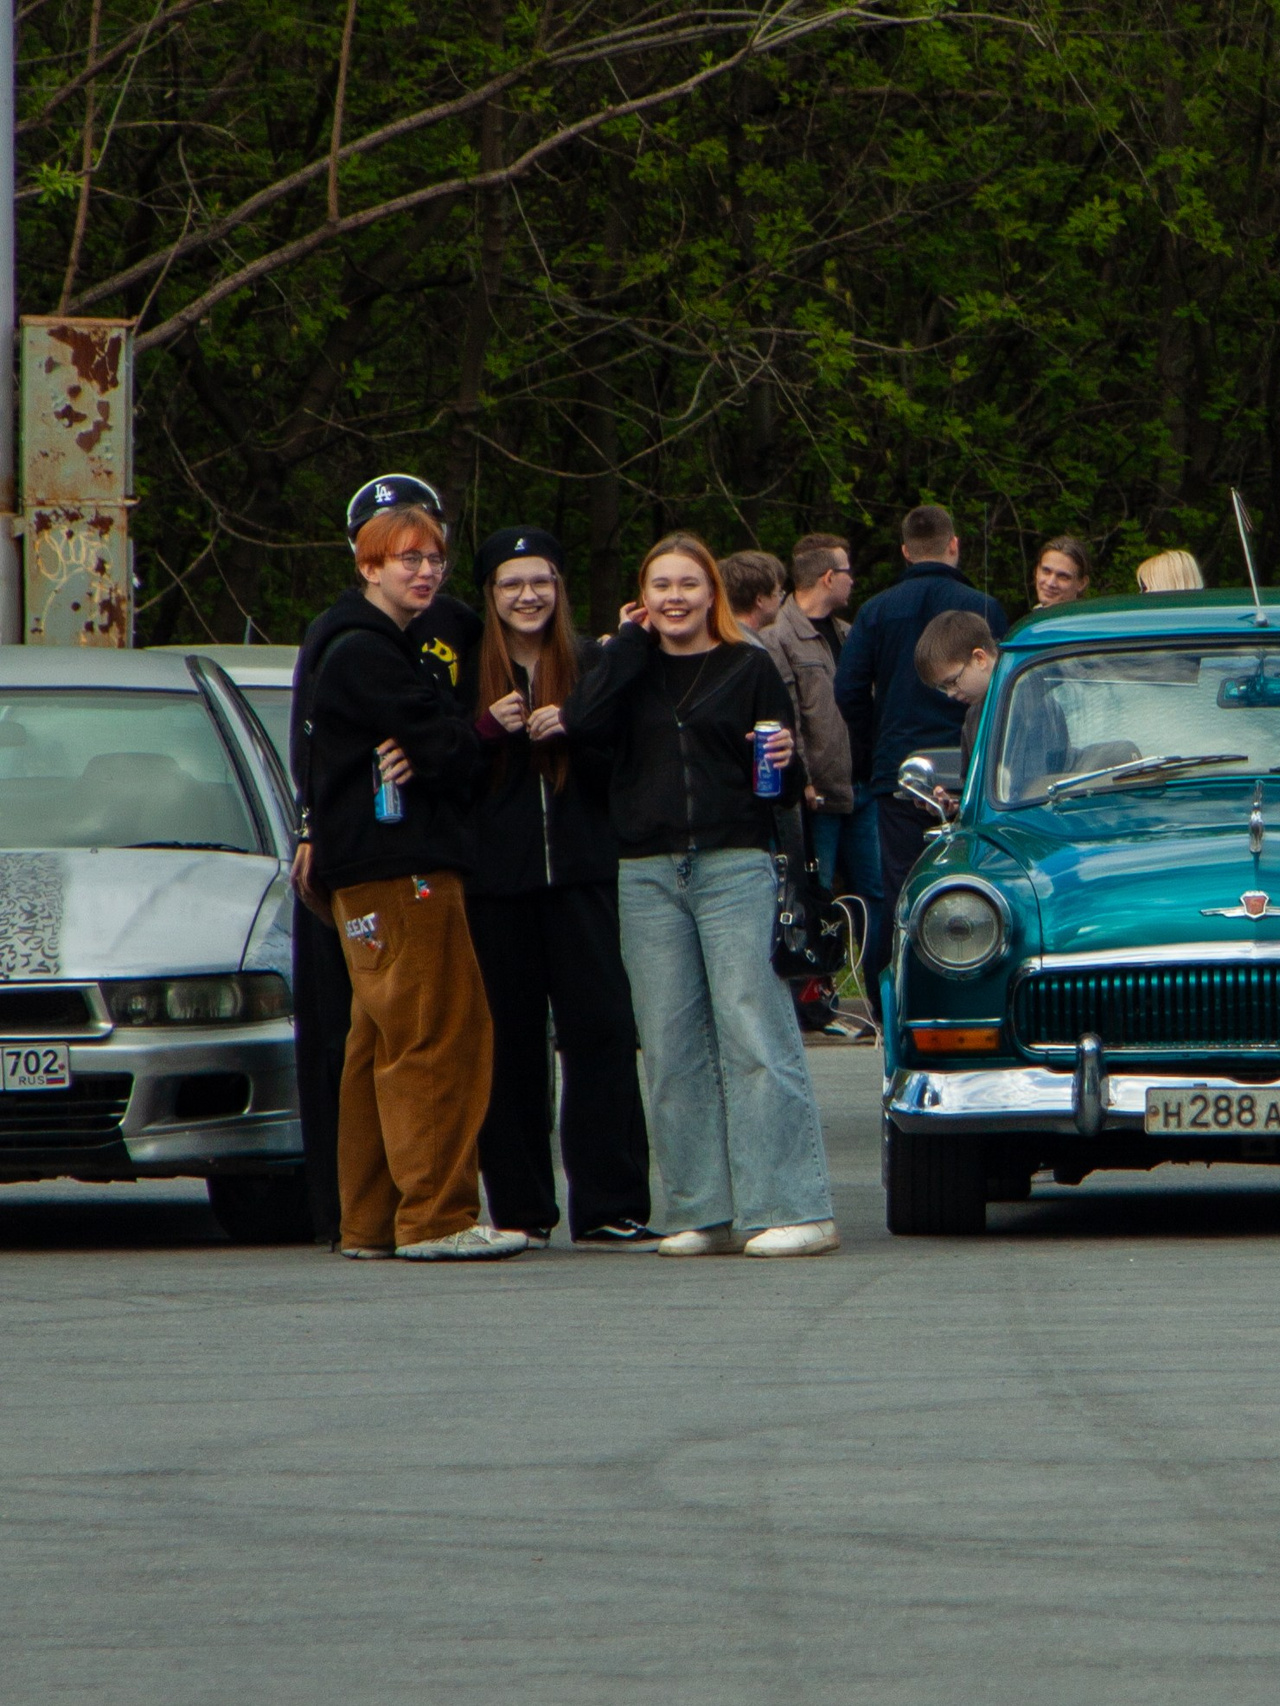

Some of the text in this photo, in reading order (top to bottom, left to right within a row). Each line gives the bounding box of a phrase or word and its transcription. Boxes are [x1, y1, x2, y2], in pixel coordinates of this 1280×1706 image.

[375, 483, 392, 503] LA
[5, 1049, 59, 1077] 702
[18, 1075, 45, 1086] RUS
